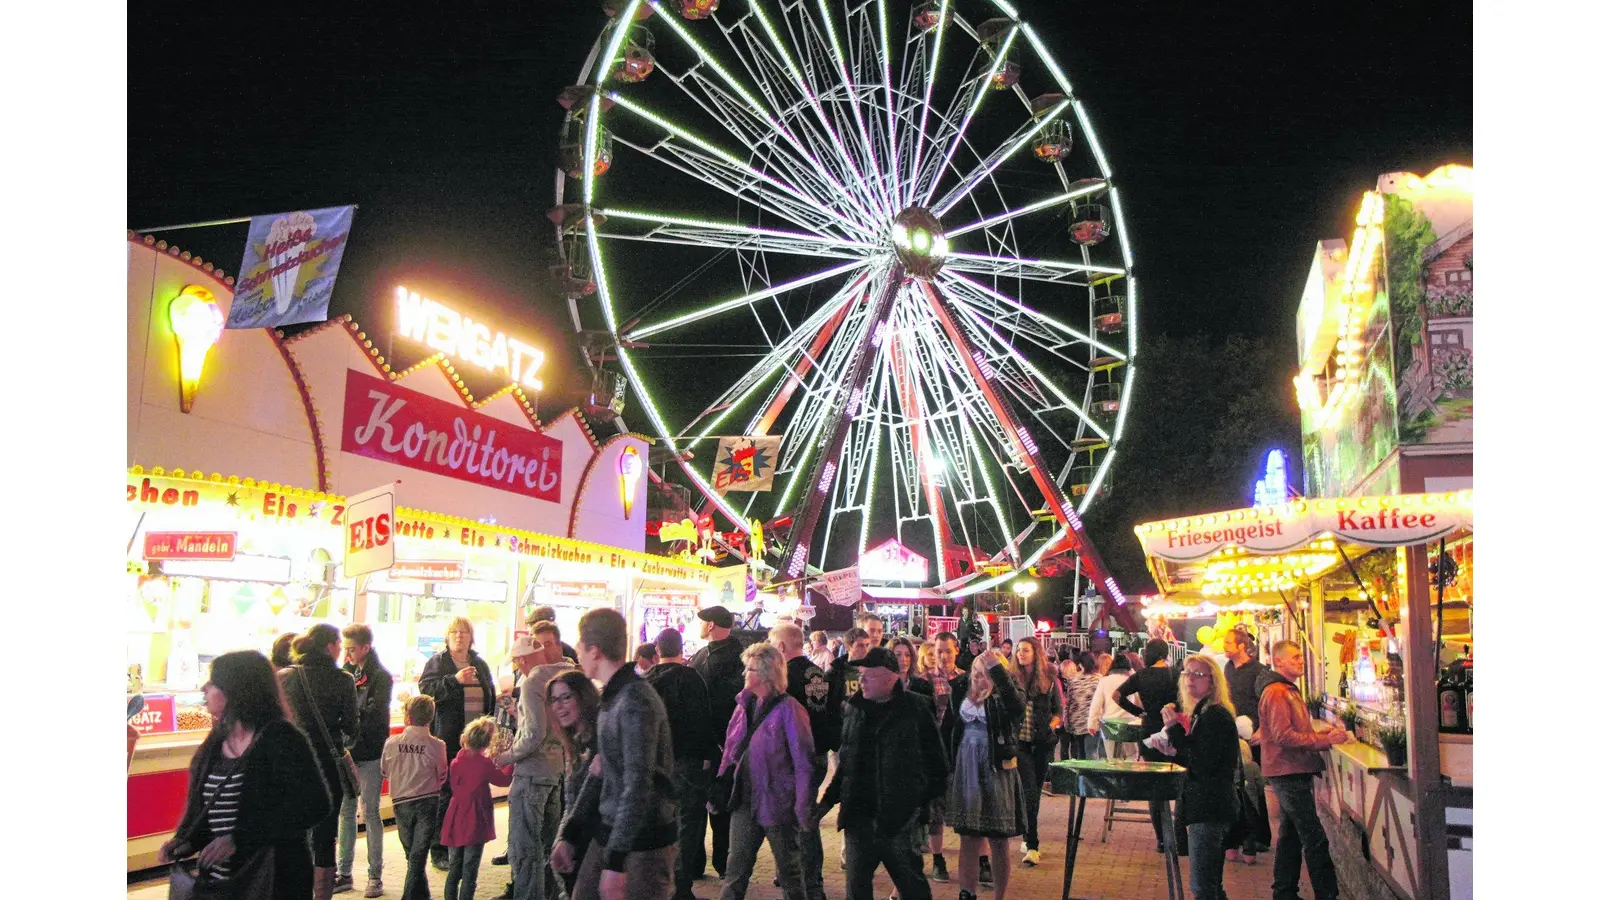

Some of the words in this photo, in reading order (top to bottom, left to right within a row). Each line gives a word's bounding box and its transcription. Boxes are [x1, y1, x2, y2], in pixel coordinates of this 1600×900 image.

[394, 284, 546, 391] WENGATZ
[355, 390, 558, 492] Konditorei
[715, 464, 751, 489] EIS
[176, 535, 229, 553] Mandeln
[263, 492, 297, 518] Eis
[460, 527, 485, 548] Eis
[611, 553, 626, 569] Eis
[349, 513, 390, 554] EIS
[1167, 517, 1285, 549] Friesengeist
[1337, 507, 1438, 531] Kaffee
[127, 711, 162, 725] GATZ
